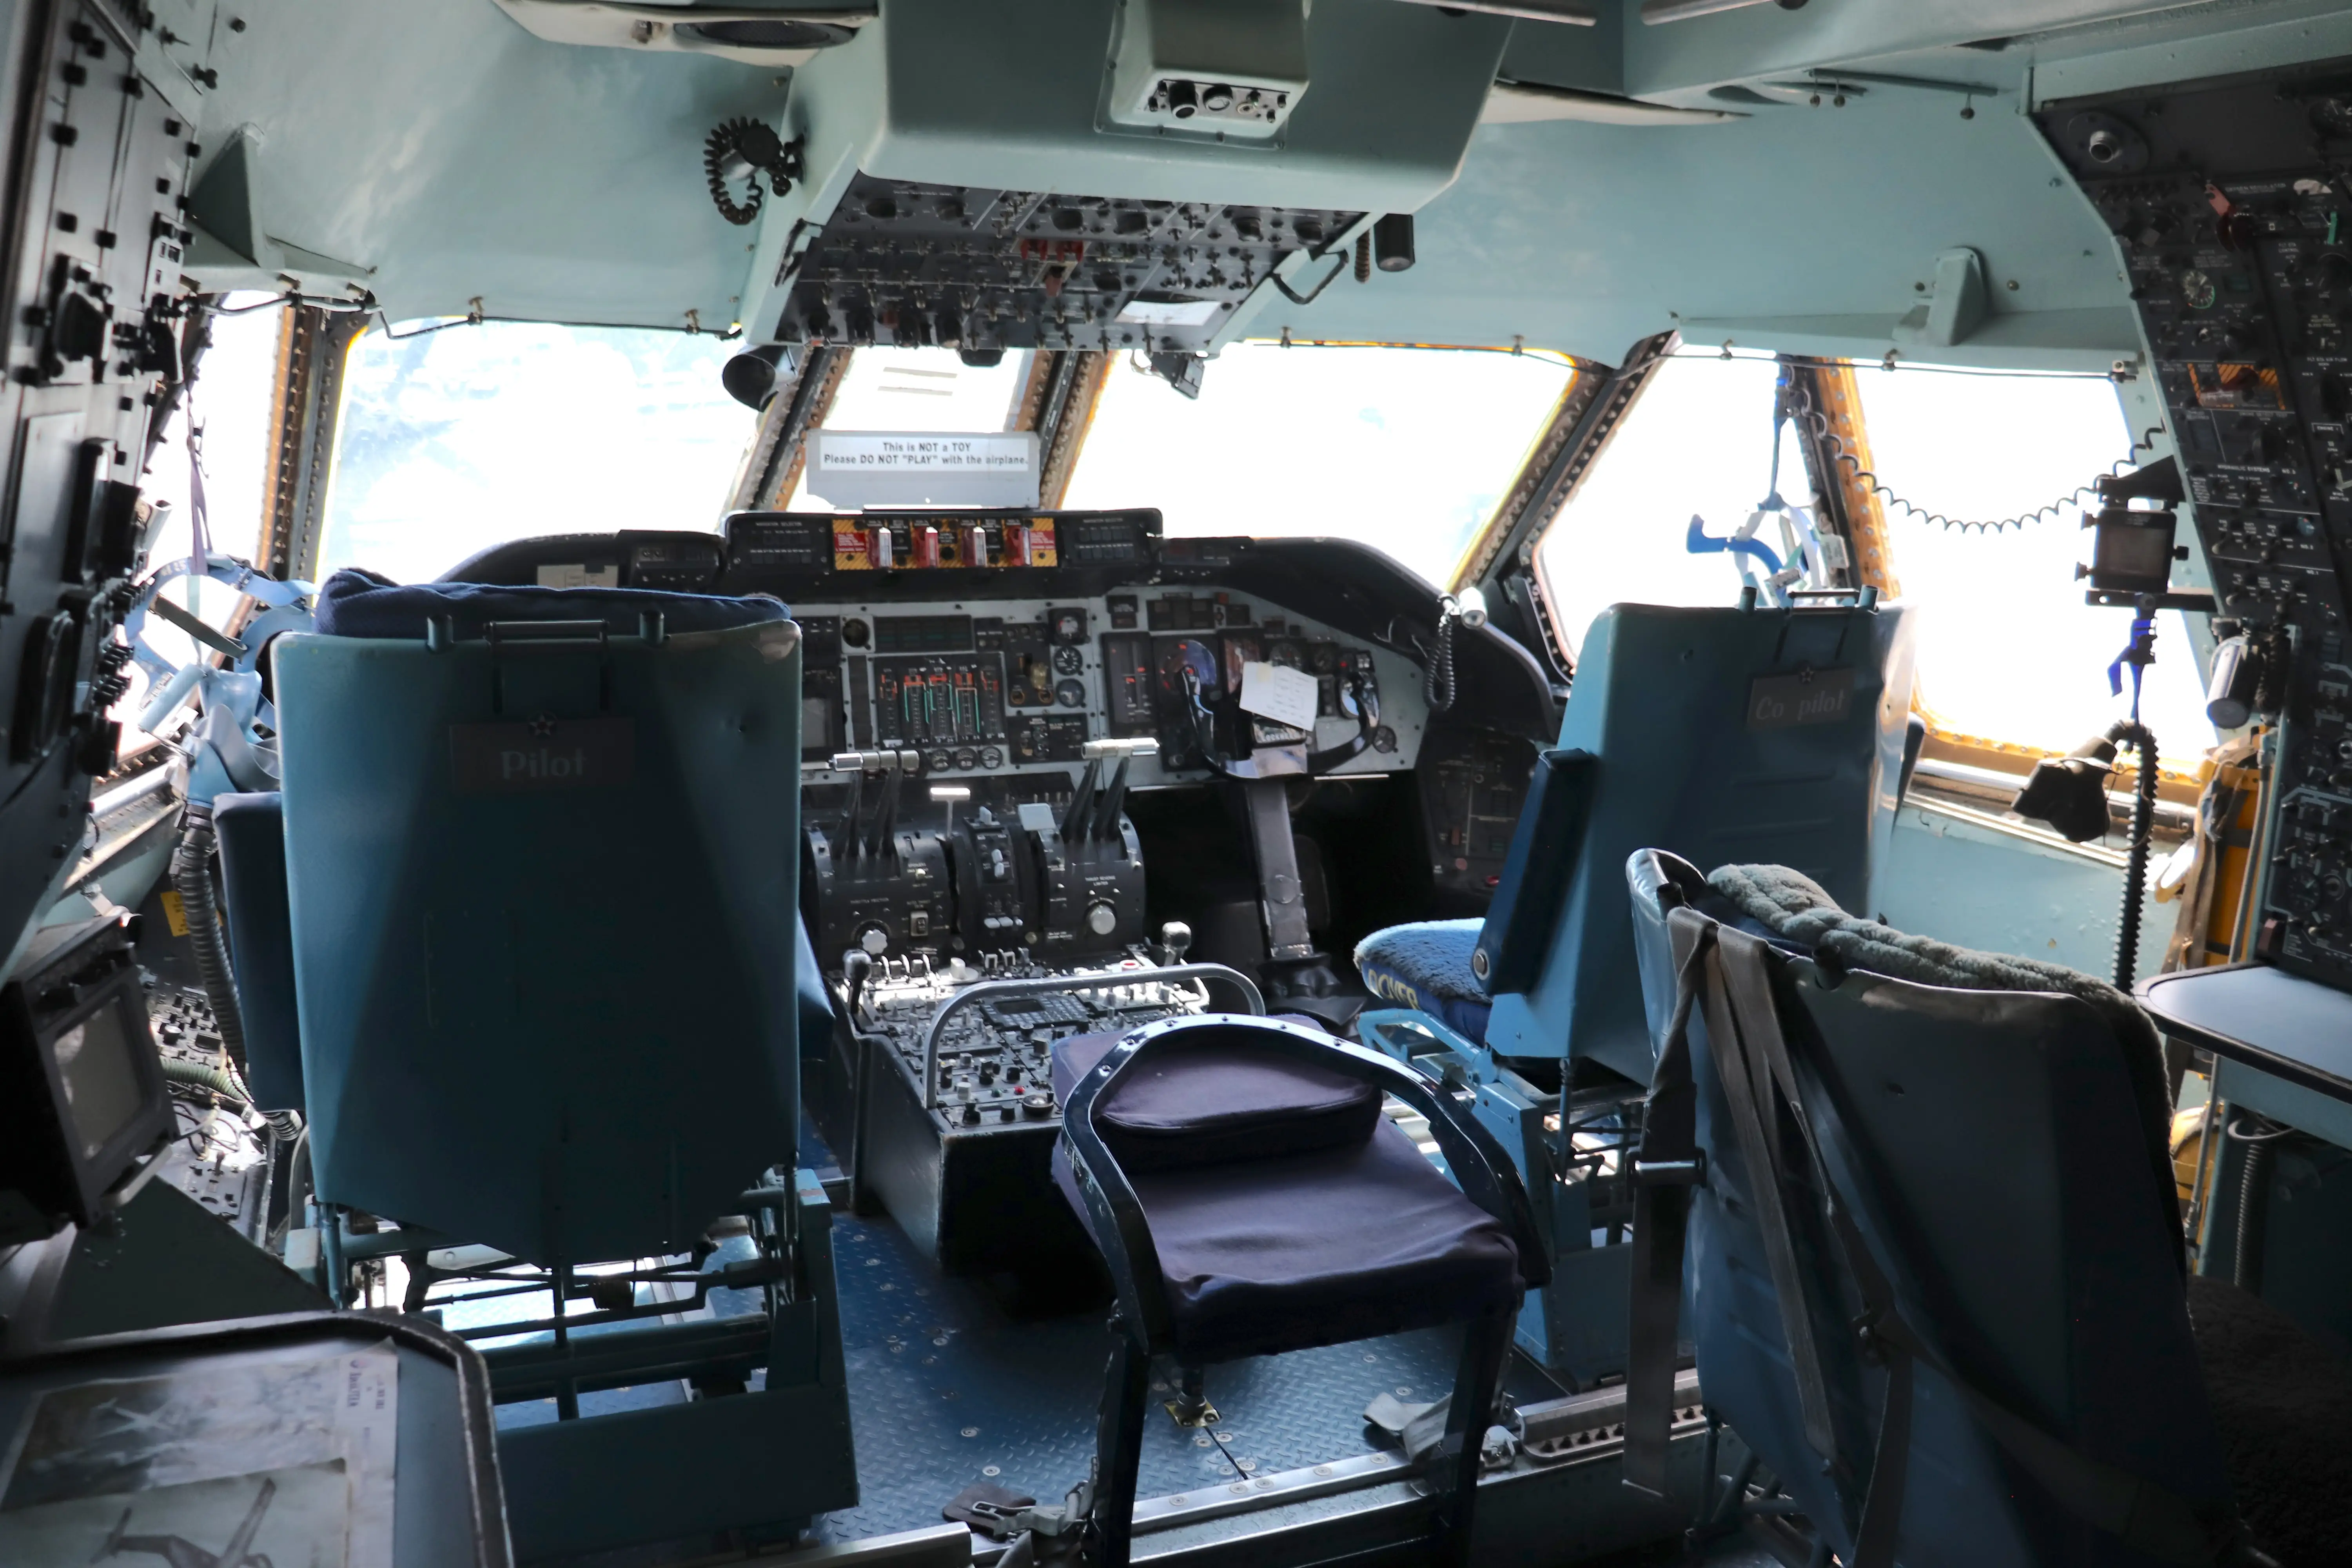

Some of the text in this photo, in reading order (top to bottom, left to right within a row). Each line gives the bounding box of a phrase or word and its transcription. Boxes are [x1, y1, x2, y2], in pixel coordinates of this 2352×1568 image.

[883, 441, 903, 452] This
[907, 442, 915, 452] is
[919, 442, 938, 452] NOT
[952, 442, 971, 452] TOY
[824, 454, 1028, 466] Please DO NOT "PLAY" with the airplane.
[1756, 688, 1846, 721] Co pilot
[500, 748, 586, 780] Pilot
